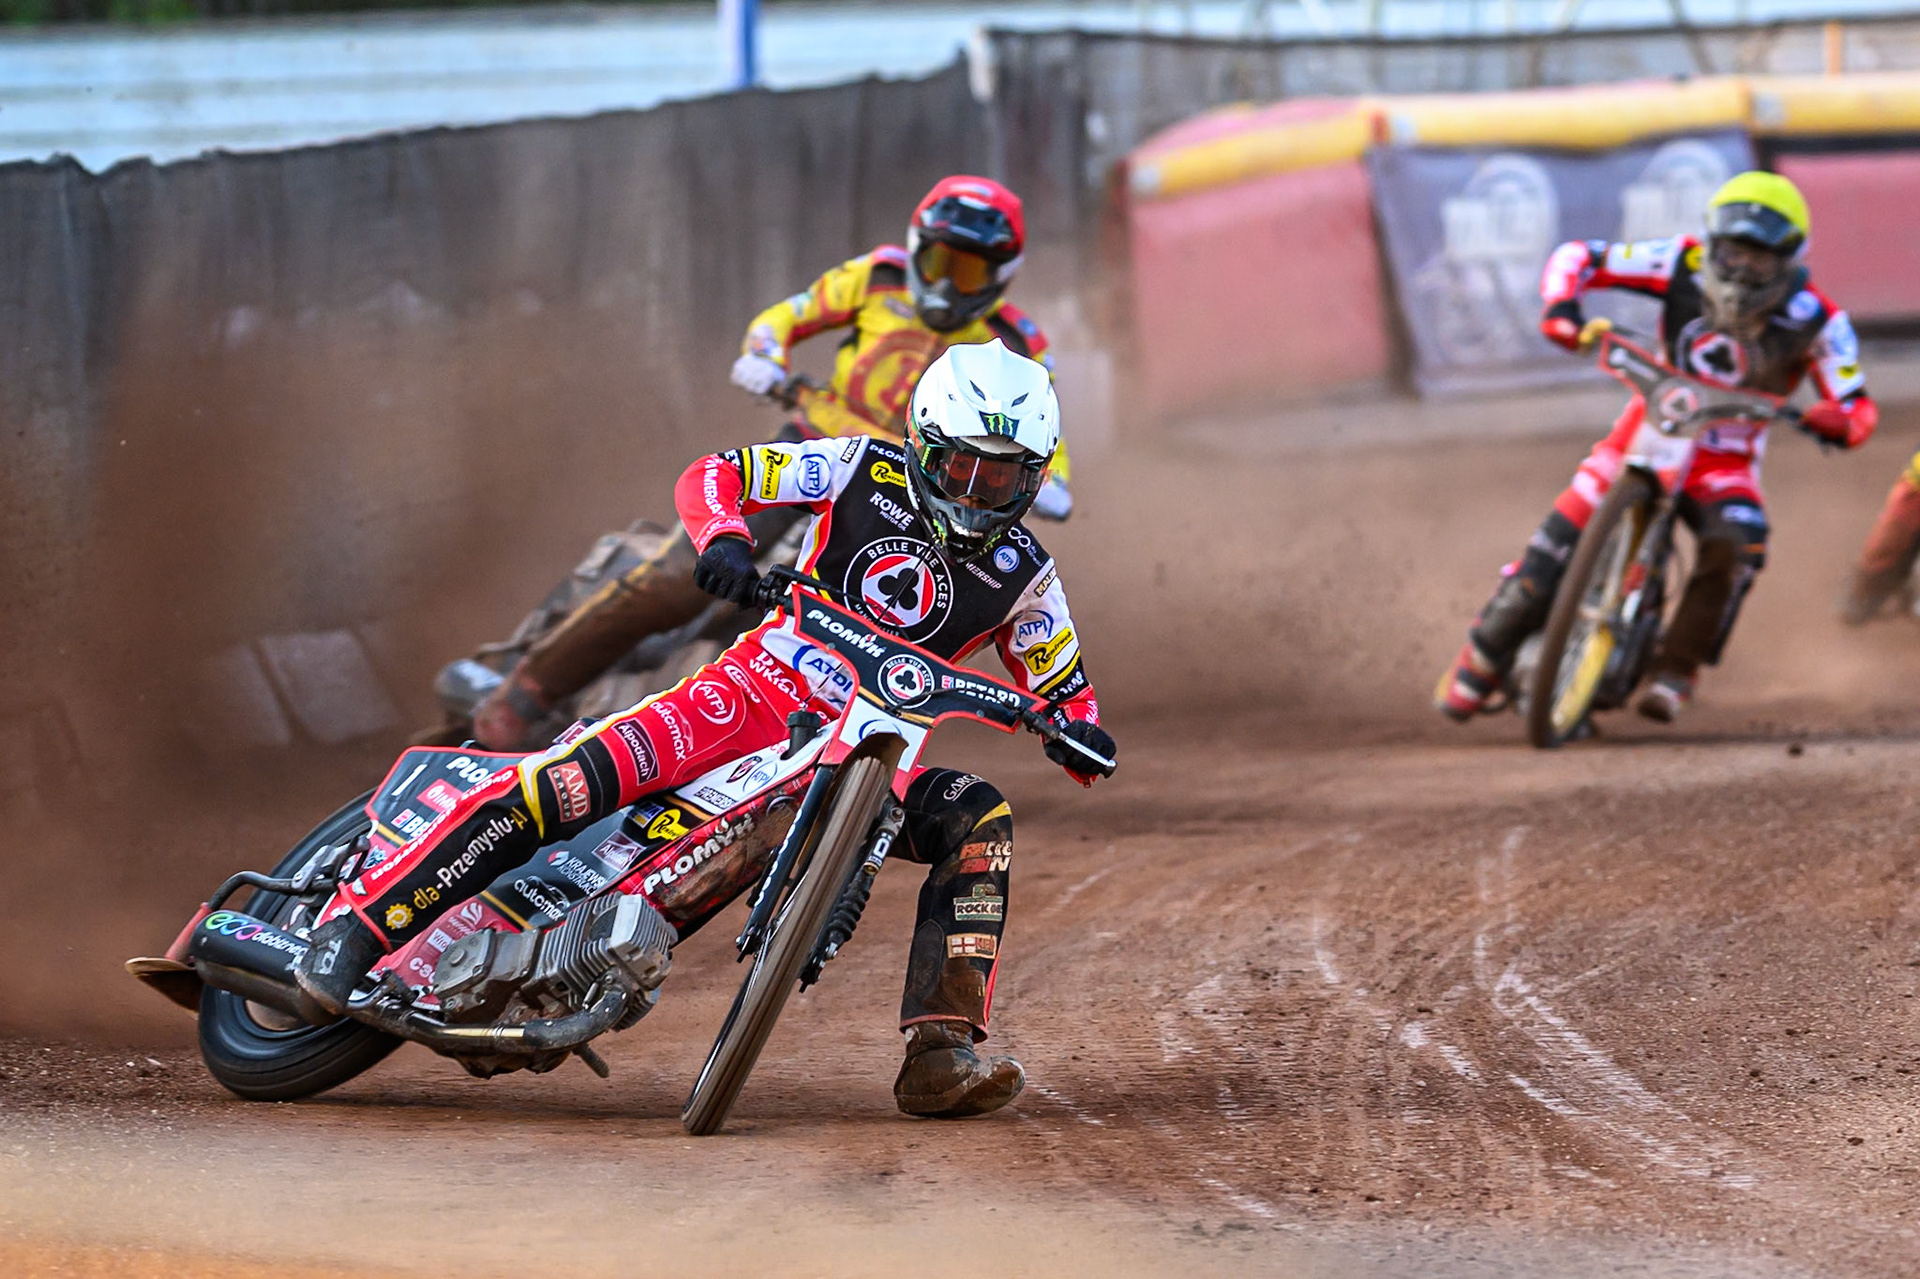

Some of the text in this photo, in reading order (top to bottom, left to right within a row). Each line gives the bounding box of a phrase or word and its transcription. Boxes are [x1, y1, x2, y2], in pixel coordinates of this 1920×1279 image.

[808, 460, 820, 491] ATPI
[870, 491, 914, 527] ROWE
[879, 510, 898, 525] MOTOR
[999, 552, 1014, 566] ATPI
[867, 542, 948, 609] BELLE VUE ACES
[1018, 618, 1047, 638] ATPI
[699, 685, 727, 716] ATPI
[619, 724, 650, 777] Alpodach
[553, 770, 570, 817] GROUP
[562, 767, 588, 817] AMD
[956, 902, 989, 913] ROCK
